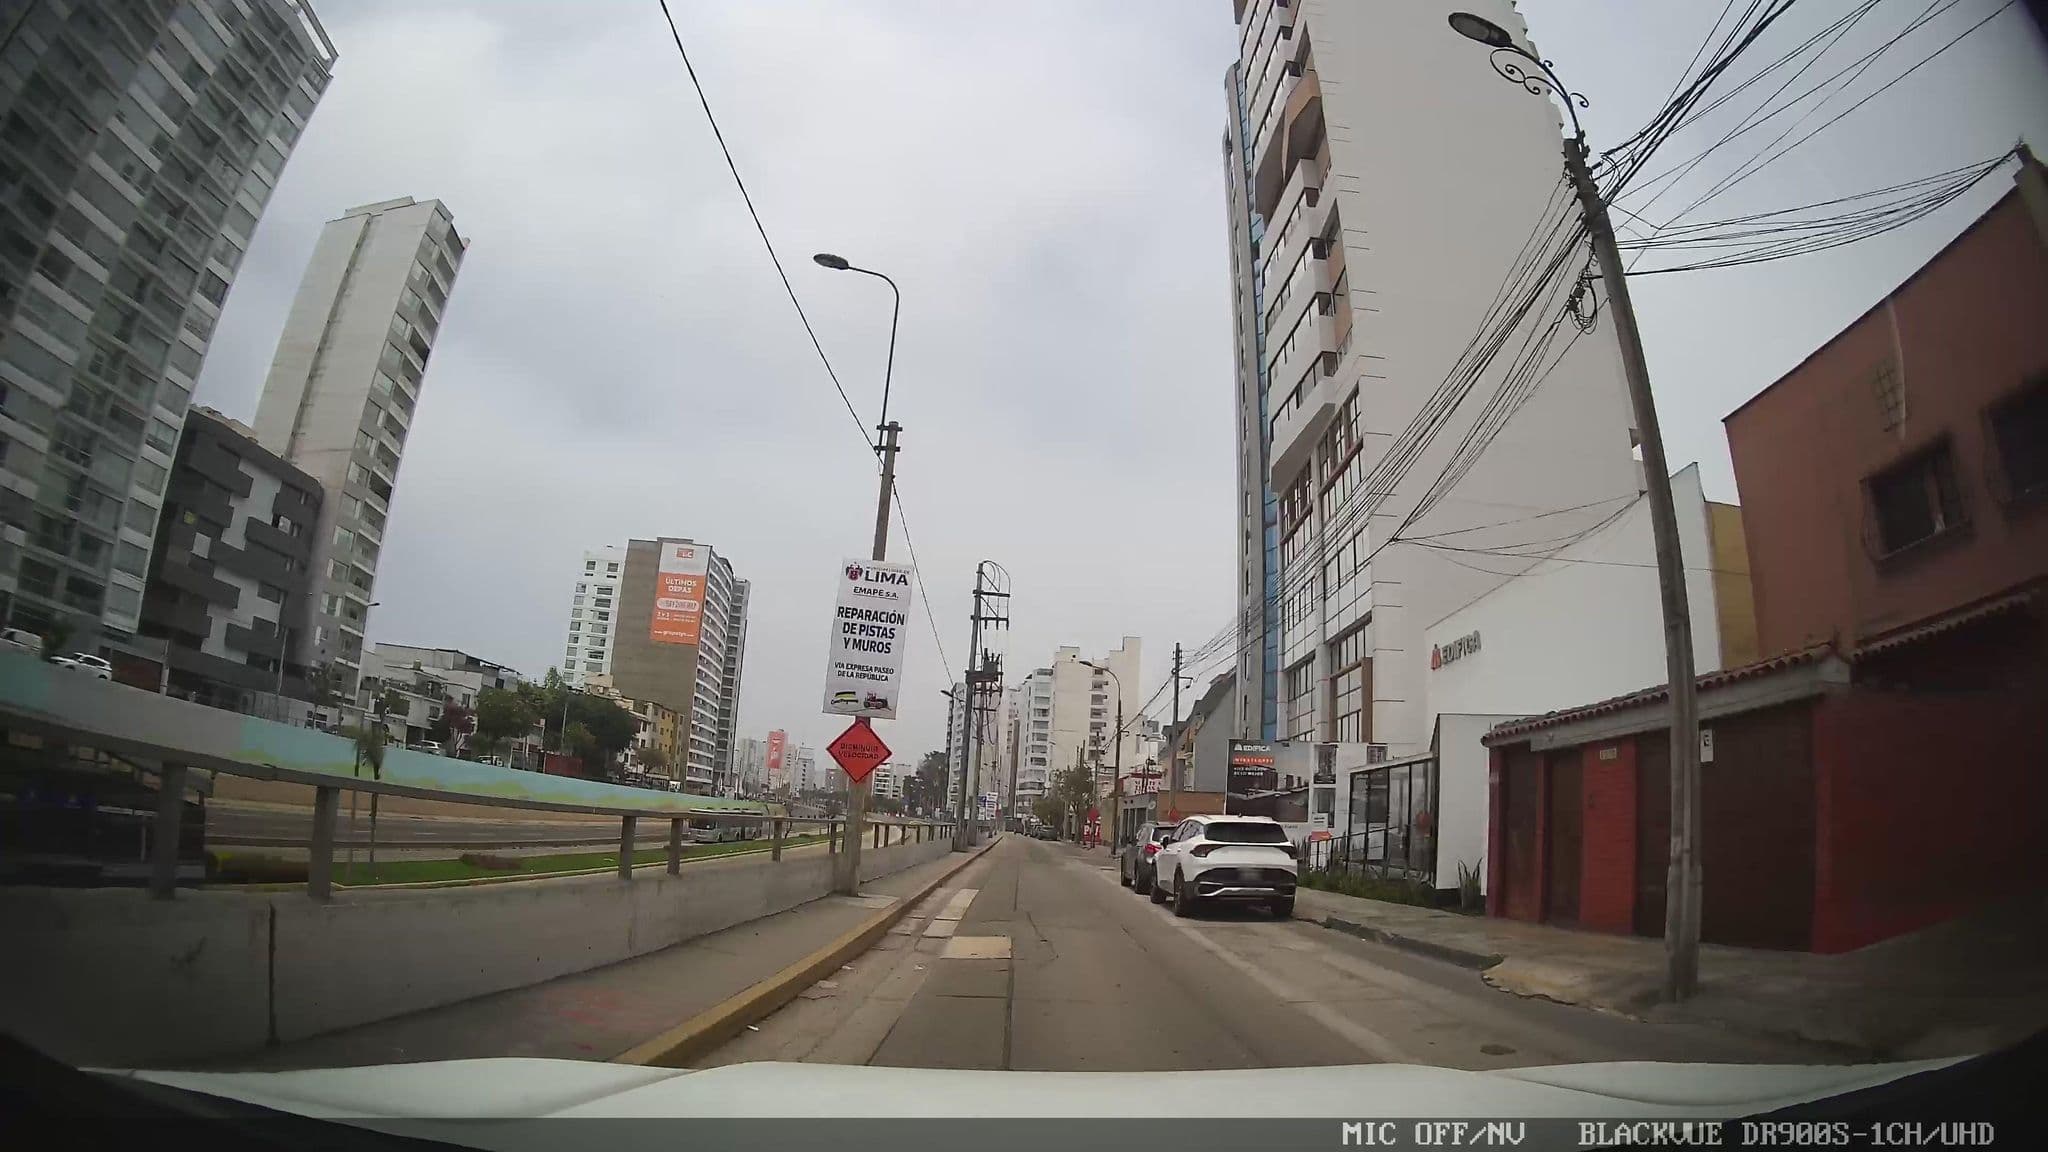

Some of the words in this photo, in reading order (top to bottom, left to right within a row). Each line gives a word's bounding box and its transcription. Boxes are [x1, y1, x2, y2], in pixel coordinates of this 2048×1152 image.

[865, 570, 908, 586] LIMA
[853, 586, 884, 597] EMAPE
[837, 606, 905, 625] REPARACIÓN
[842, 621, 858, 635] DE
[859, 623, 896, 640] PISTAS
[843, 637, 851, 649] Y
[852, 638, 892, 654] MUROS
[1442, 630, 1481, 665] EDIFICA
[845, 663, 873, 673] EXPRESA
[874, 666, 895, 674] PASEO
